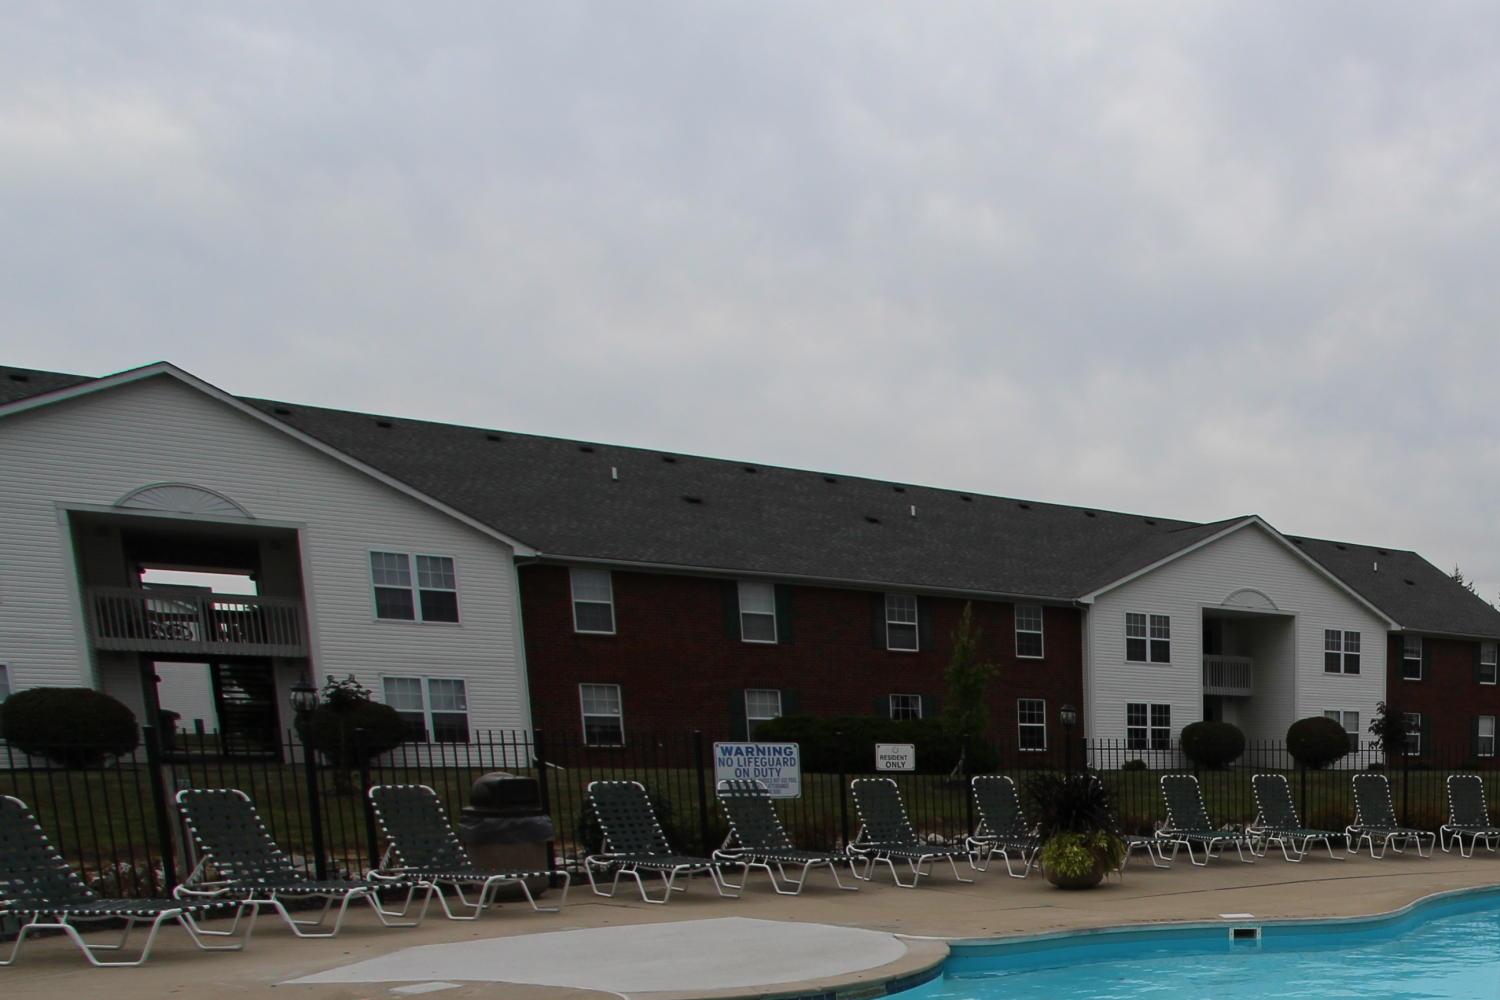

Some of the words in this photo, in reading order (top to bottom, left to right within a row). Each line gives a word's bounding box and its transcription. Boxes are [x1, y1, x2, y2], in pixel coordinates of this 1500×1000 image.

[720, 746, 794, 757] WARNING
[718, 757, 734, 768] NO
[737, 757, 796, 768] LIFEGUARD
[885, 761, 906, 769] ONLY
[734, 768, 750, 778] ON
[753, 768, 782, 778] DUTY
